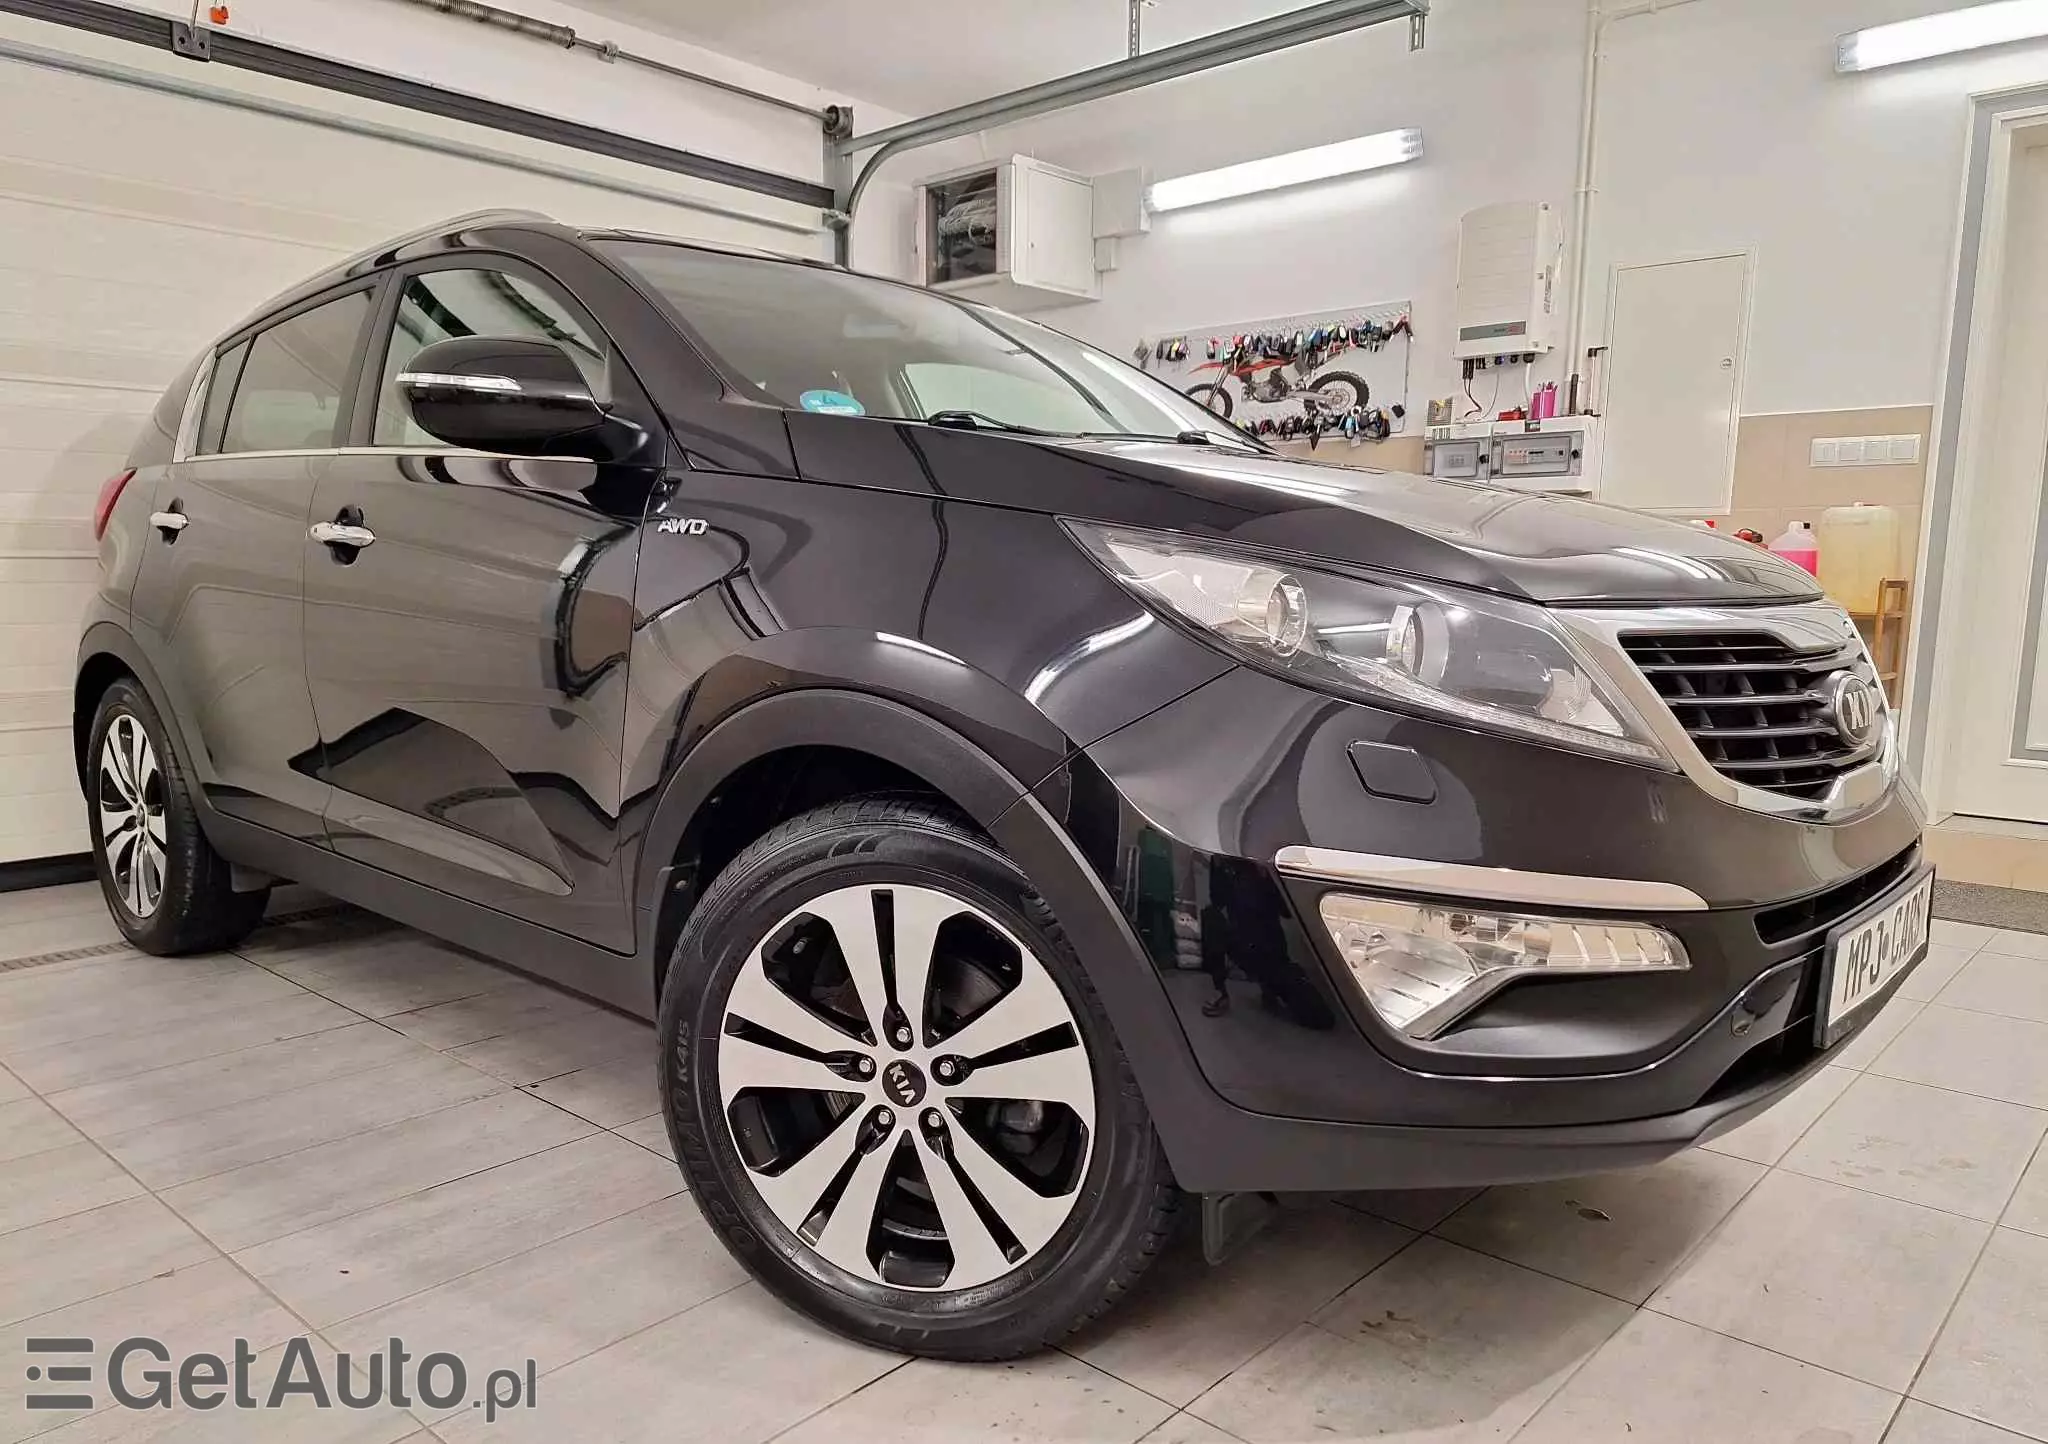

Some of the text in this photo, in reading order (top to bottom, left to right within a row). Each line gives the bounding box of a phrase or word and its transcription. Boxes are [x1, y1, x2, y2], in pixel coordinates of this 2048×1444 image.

[657, 518, 709, 535] AWD
[1842, 887, 1924, 1004] MPJ CARS
[889, 1063, 916, 1104] KIA
